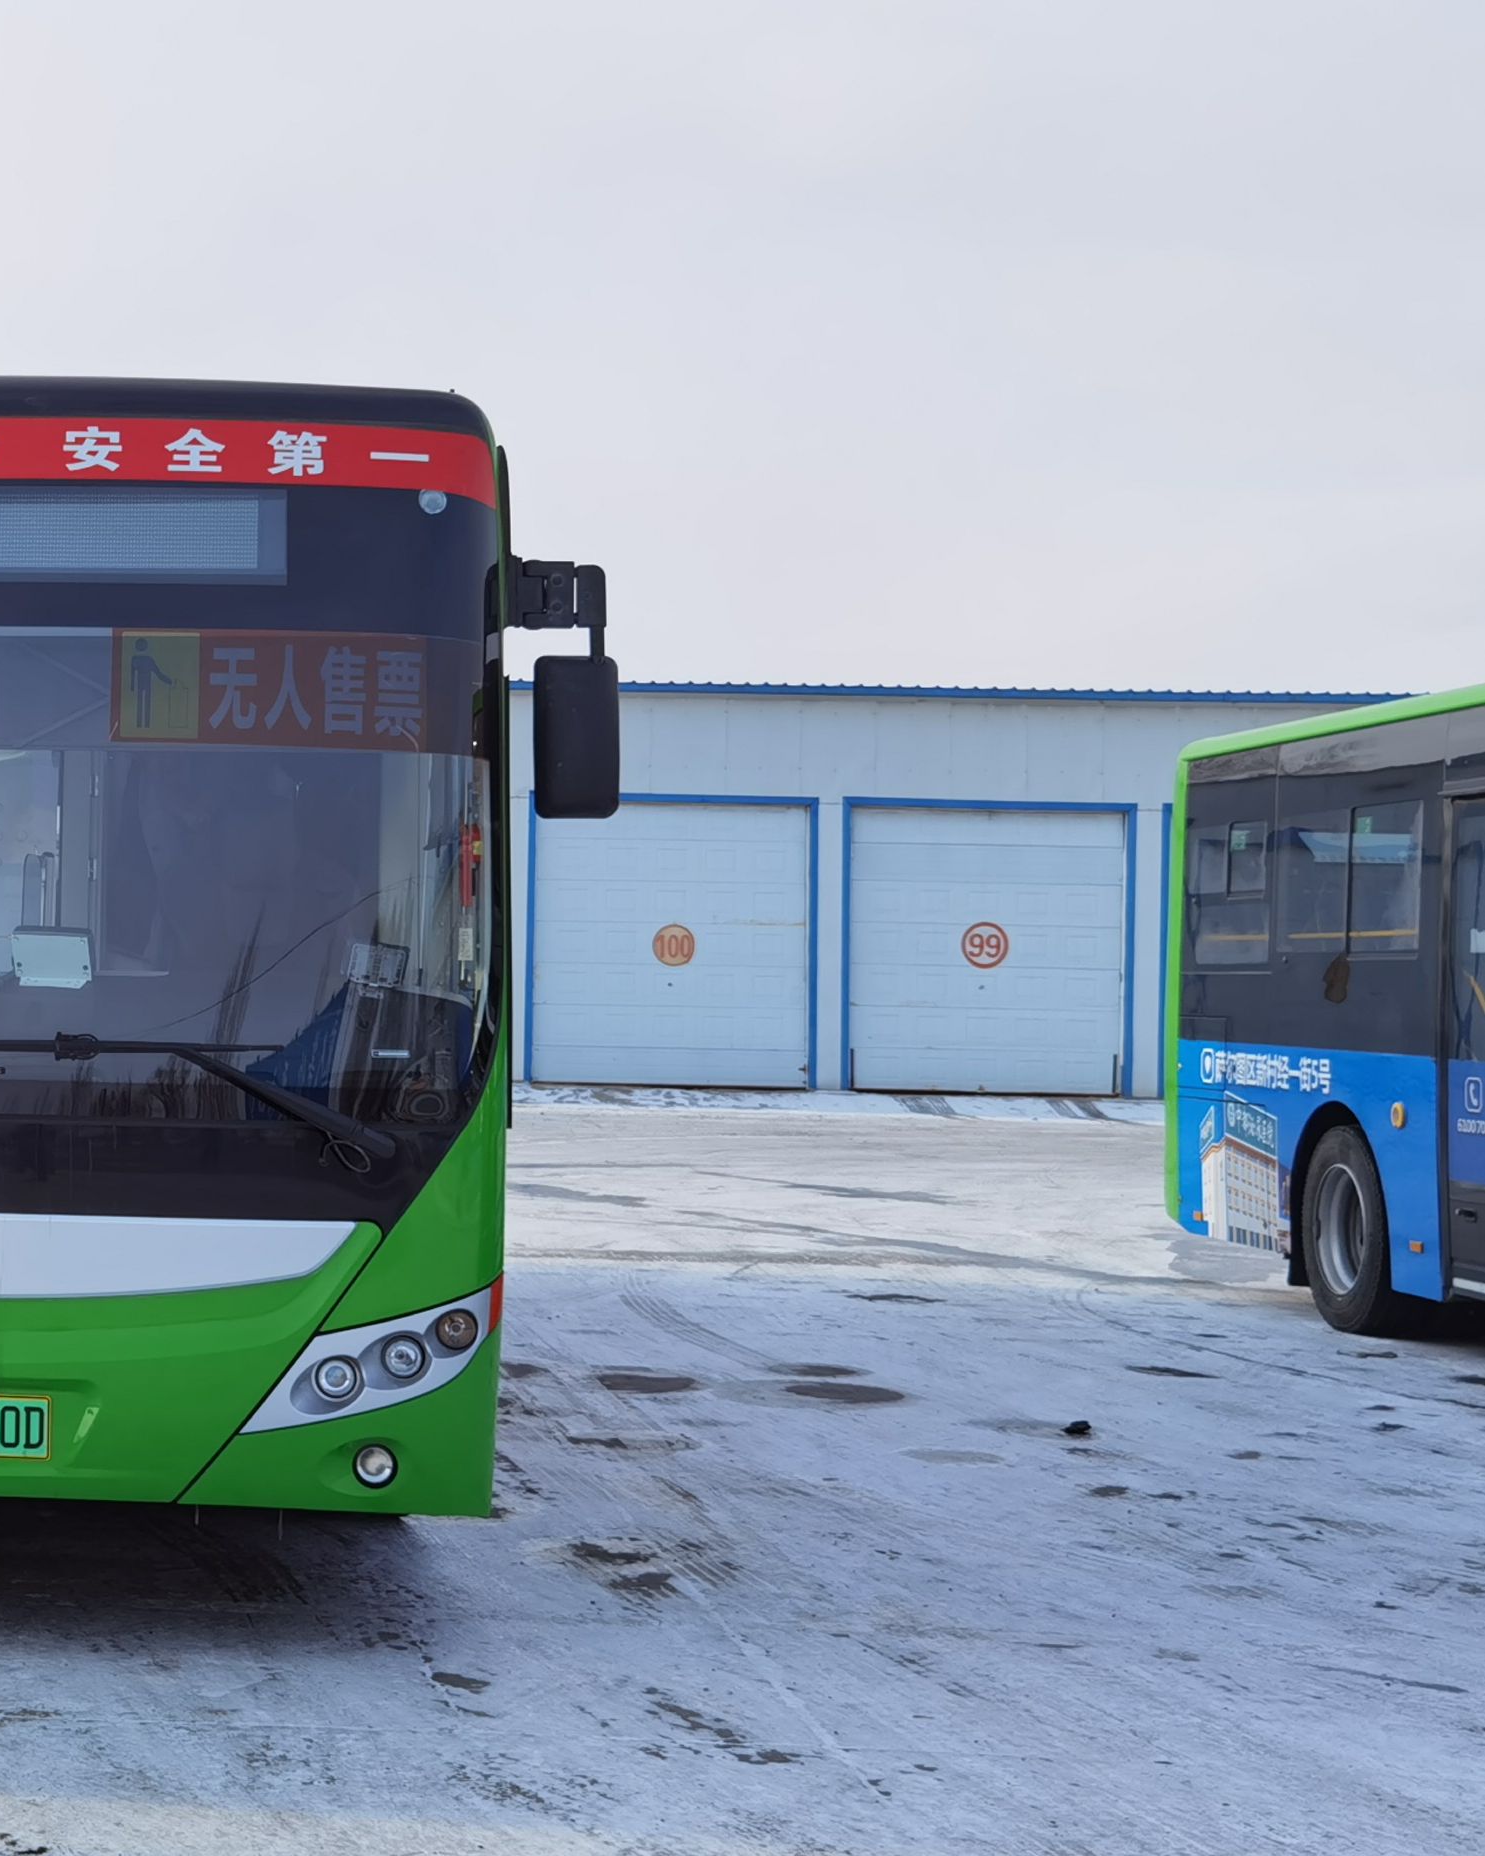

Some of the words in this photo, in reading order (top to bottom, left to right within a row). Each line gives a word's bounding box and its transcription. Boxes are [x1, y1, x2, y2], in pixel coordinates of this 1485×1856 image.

[63, 426, 430, 476] 安全第一
[209, 644, 423, 737] 无人售票
[657, 934, 692, 959] 100
[969, 933, 1001, 958] 99
